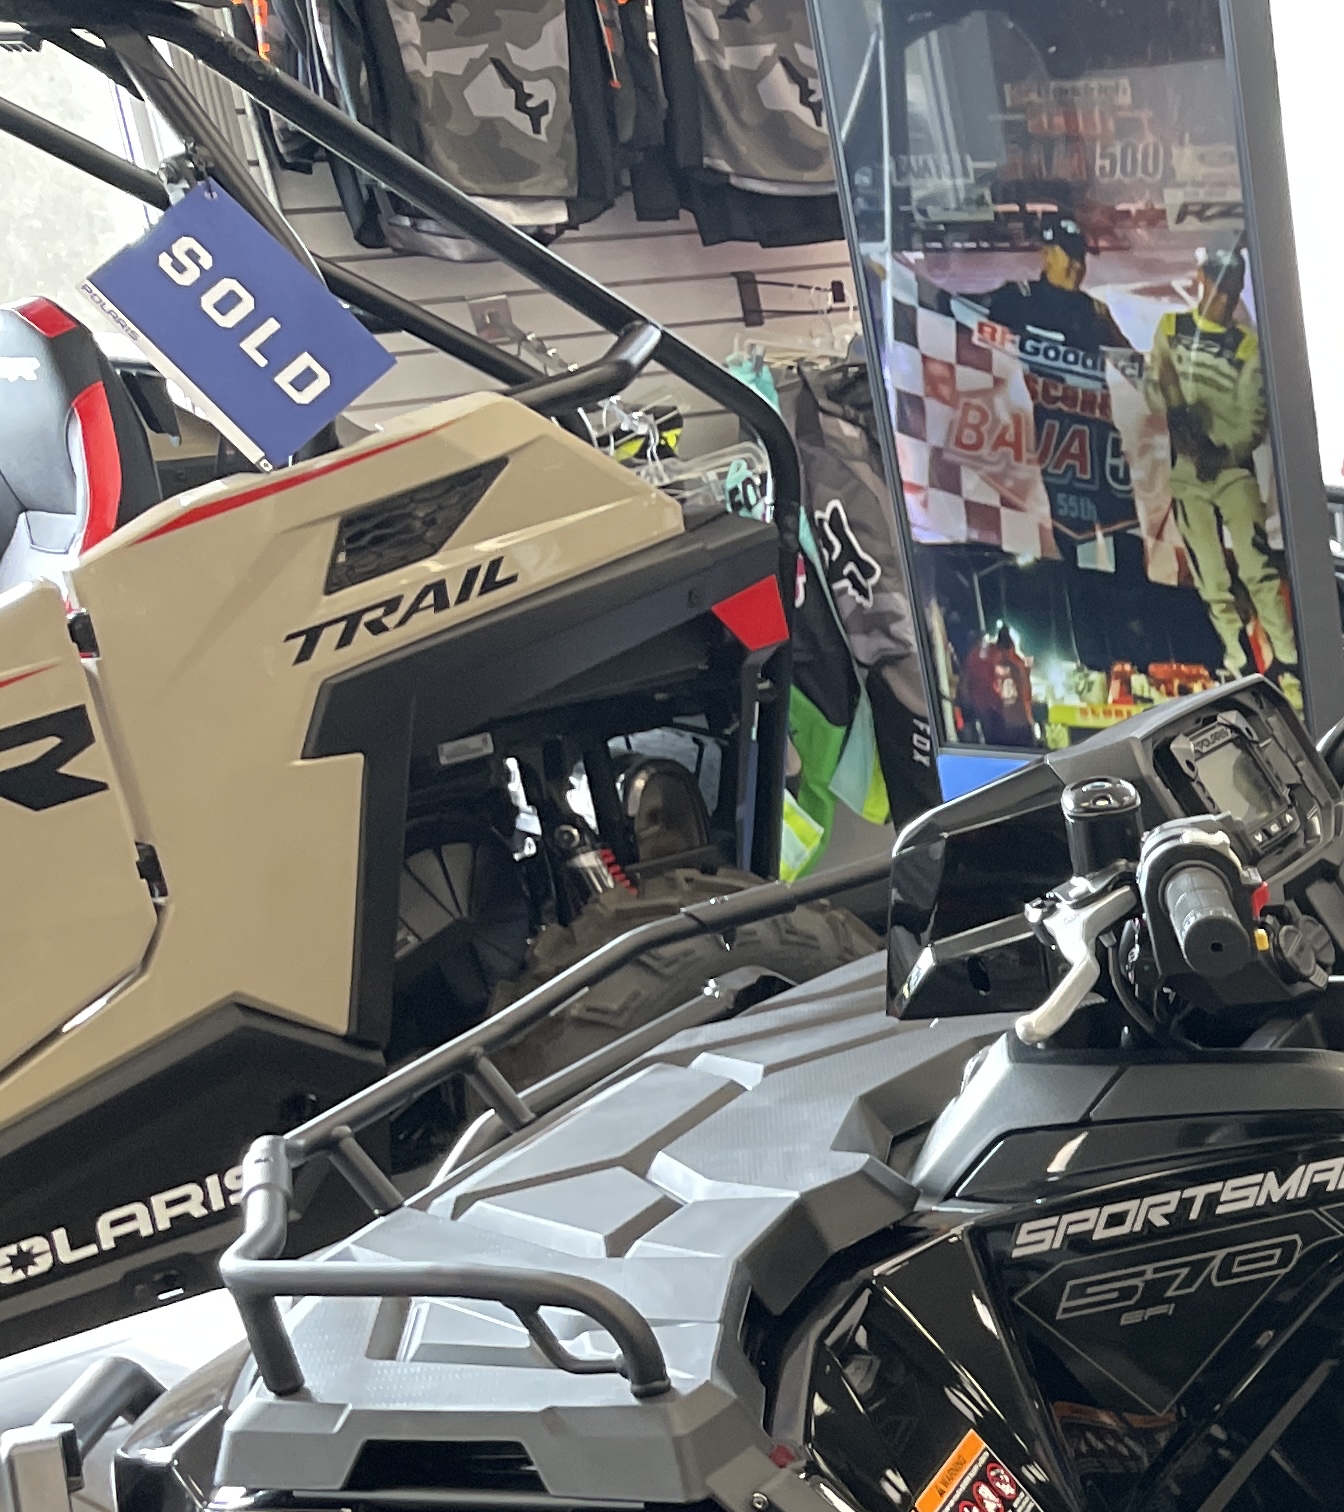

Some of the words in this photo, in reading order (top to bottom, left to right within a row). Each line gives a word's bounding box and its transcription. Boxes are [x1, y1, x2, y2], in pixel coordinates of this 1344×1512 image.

[1095, 140, 1164, 181] 500
[80, 283, 141, 342] POLARIS
[158, 236, 331, 405] SOLD
[954, 402, 1093, 480] BAJA
[283, 555, 520, 667] TRAIL
[912, 718, 931, 768] FOX
[0, 1164, 244, 1286] OLARIS
[1056, 1233, 1303, 1321] 570
[1119, 1303, 1174, 1327] EFI
